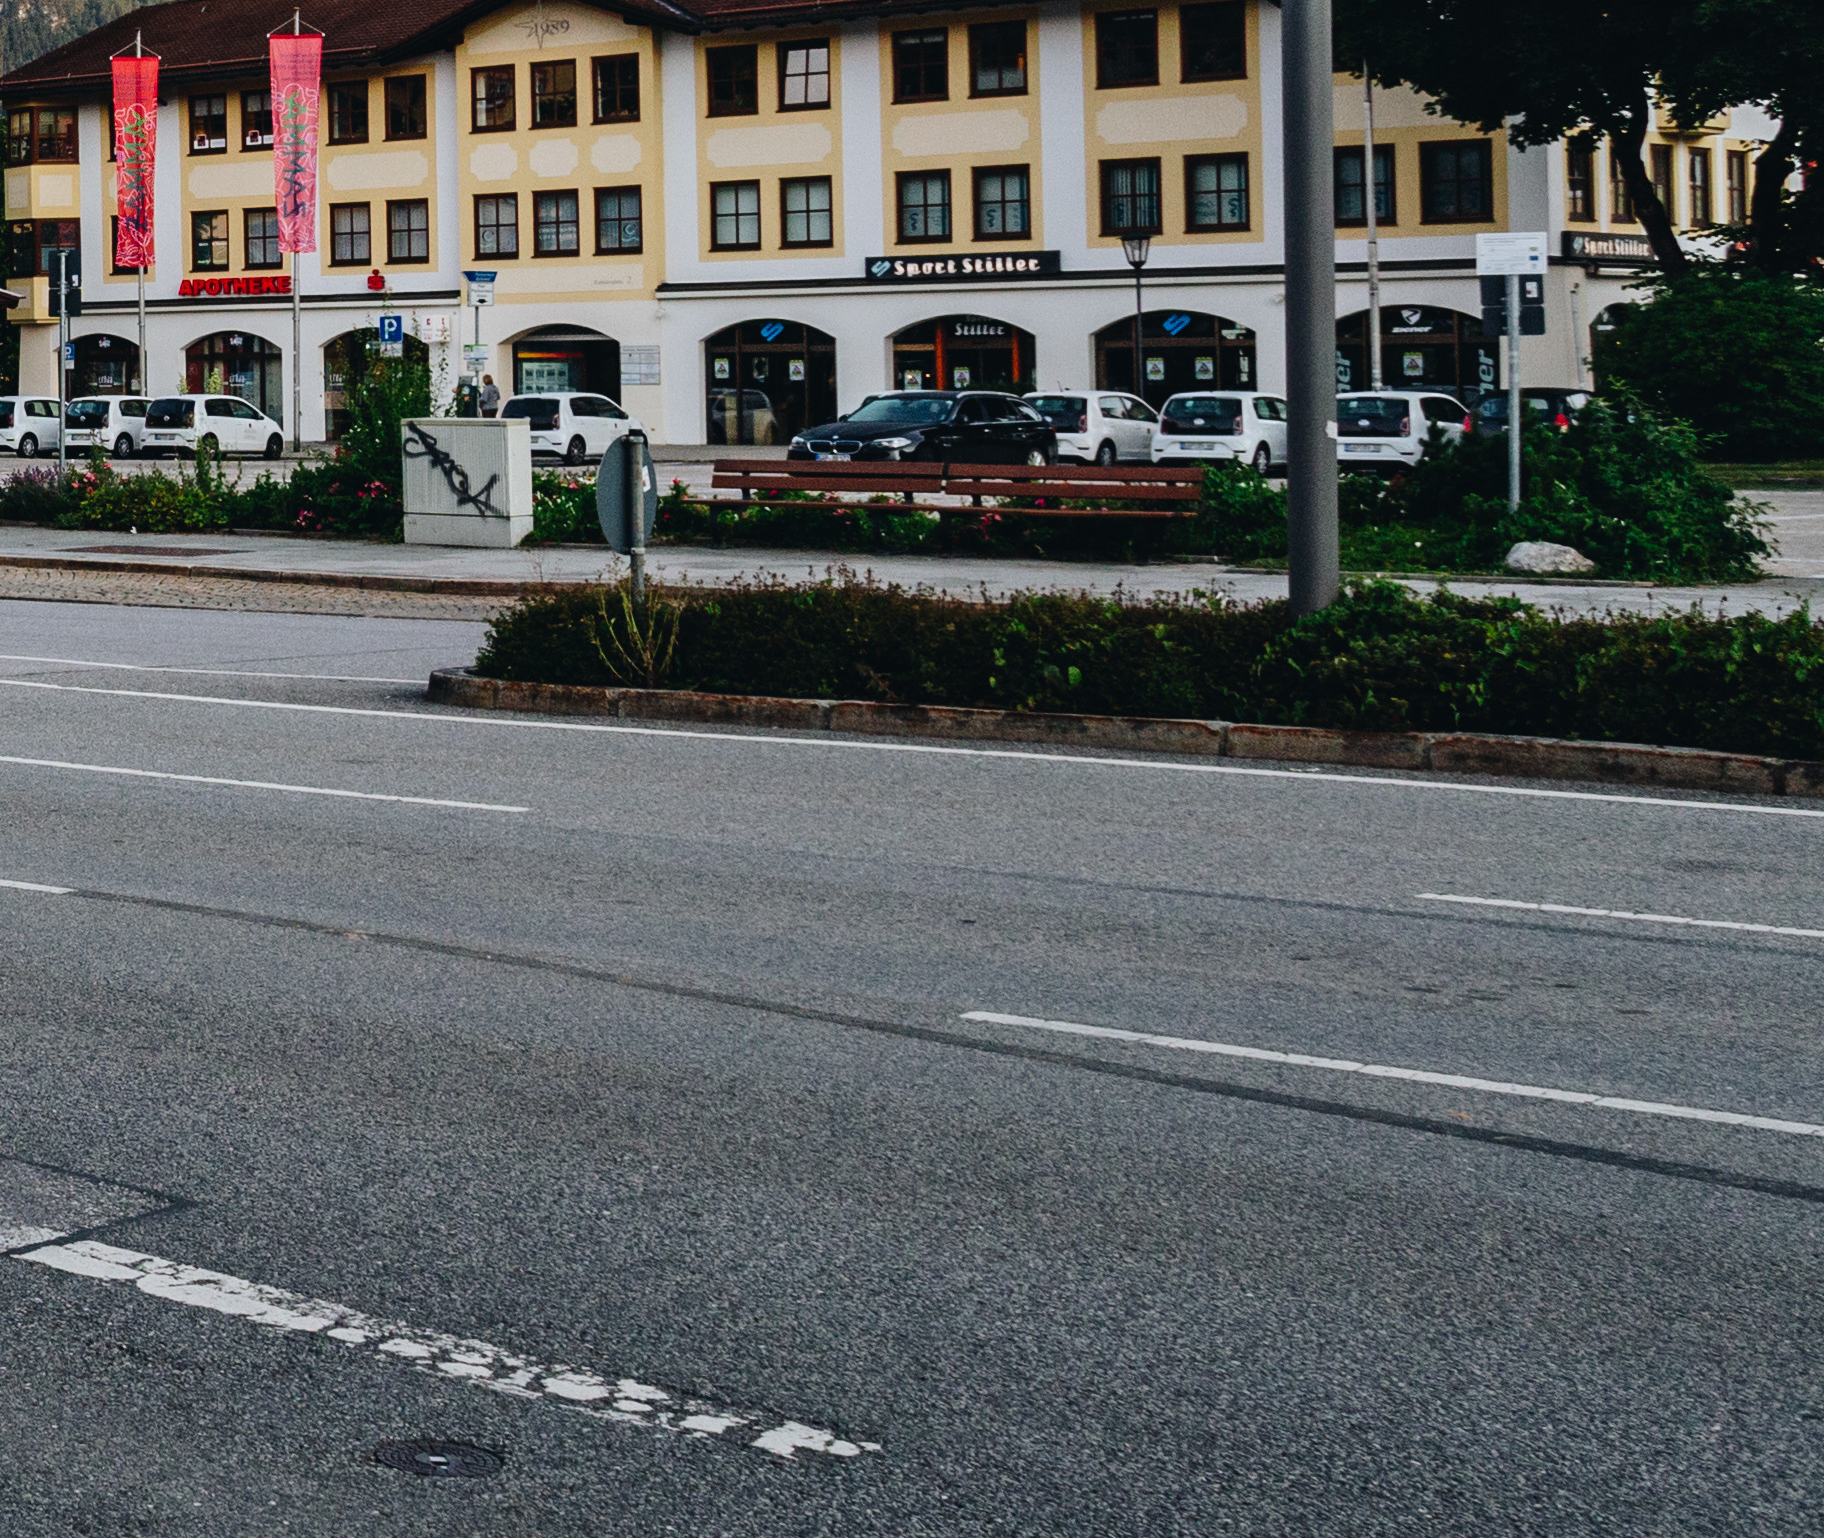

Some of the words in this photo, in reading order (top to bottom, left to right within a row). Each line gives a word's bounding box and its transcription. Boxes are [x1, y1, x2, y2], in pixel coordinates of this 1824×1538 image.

[893, 259, 957, 277] Sport
[962, 257, 1040, 273] Stiller
[178, 276, 292, 296] APOTHEKE
[384, 319, 398, 340] P
[955, 323, 1005, 335] Stiller
